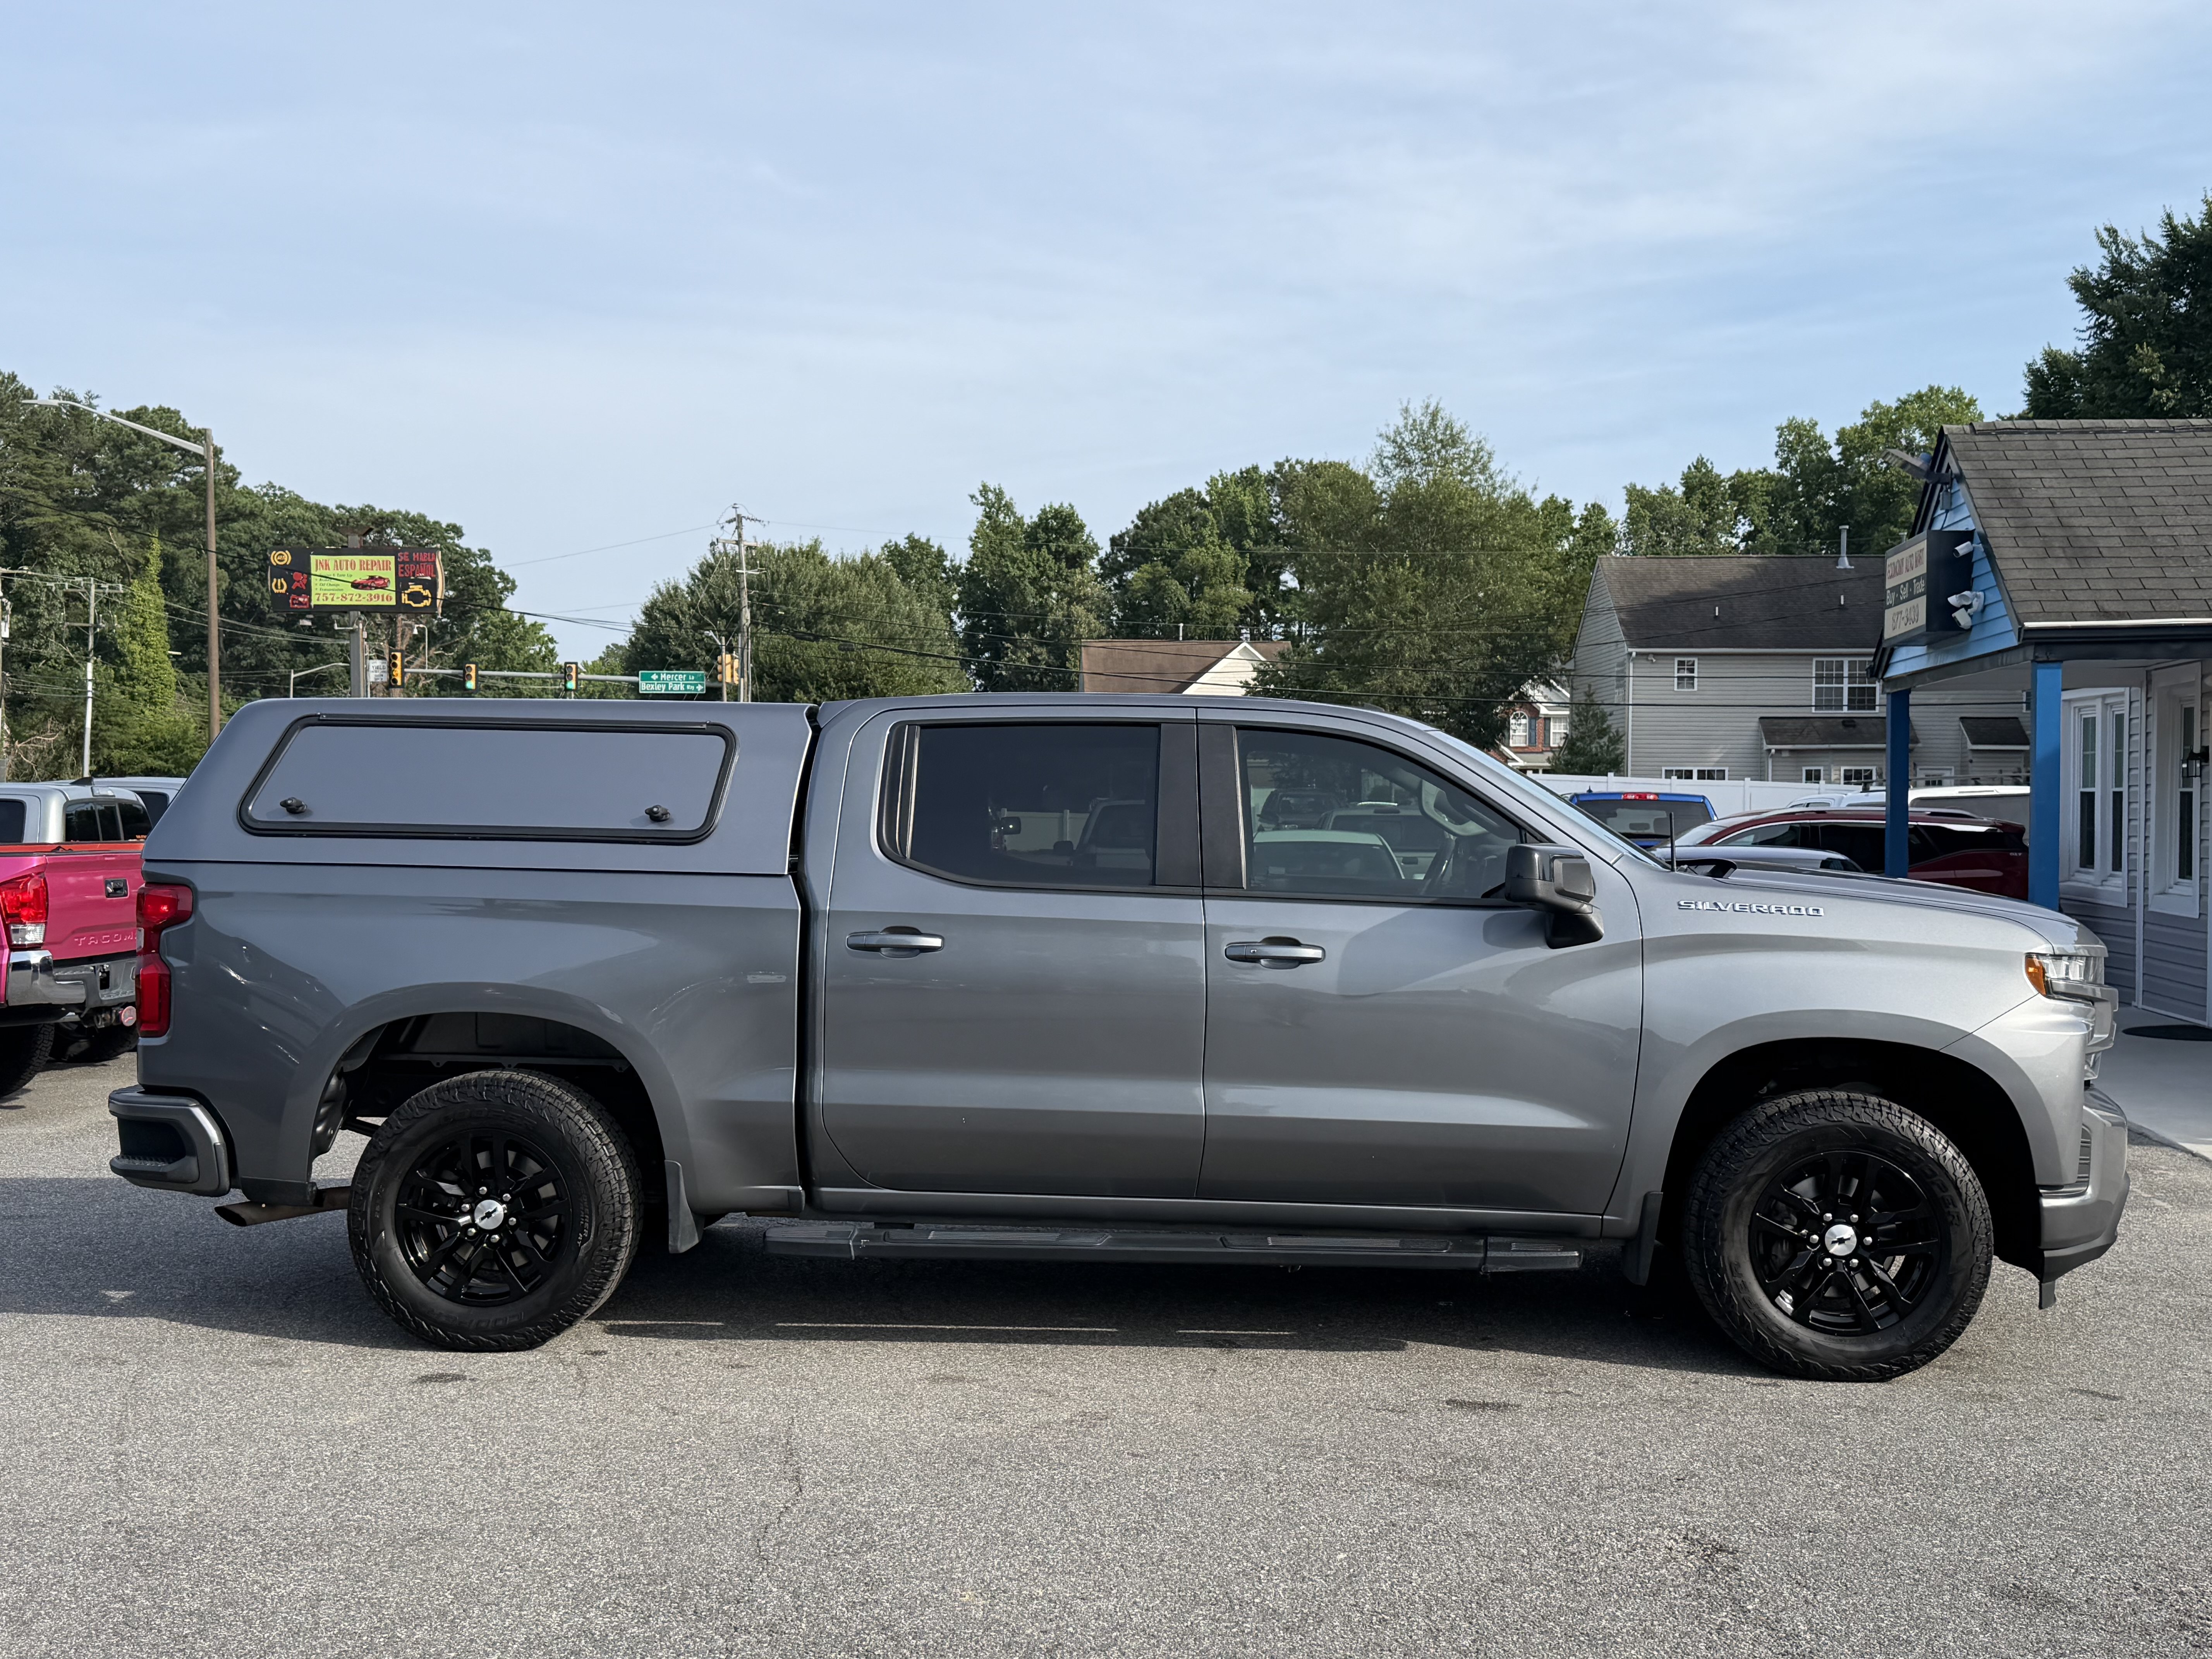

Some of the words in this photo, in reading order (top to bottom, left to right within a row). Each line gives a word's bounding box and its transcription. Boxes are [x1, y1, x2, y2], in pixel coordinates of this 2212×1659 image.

[398, 552, 409, 562] SE
[315, 559, 330, 572] JNK
[333, 559, 356, 570] AUTO
[359, 559, 392, 571] REPAIR
[315, 592, 393, 602] 757-872-3916
[1886, 589, 1895, 607] Buy
[1900, 582, 1908, 600] Sell
[1913, 576, 1925, 595] Trade
[641, 682, 666, 692] Bexley
[668, 682, 685, 690] Park
[1678, 900, 1825, 917] SILVERADO
[74, 931, 137, 946] TACOM
